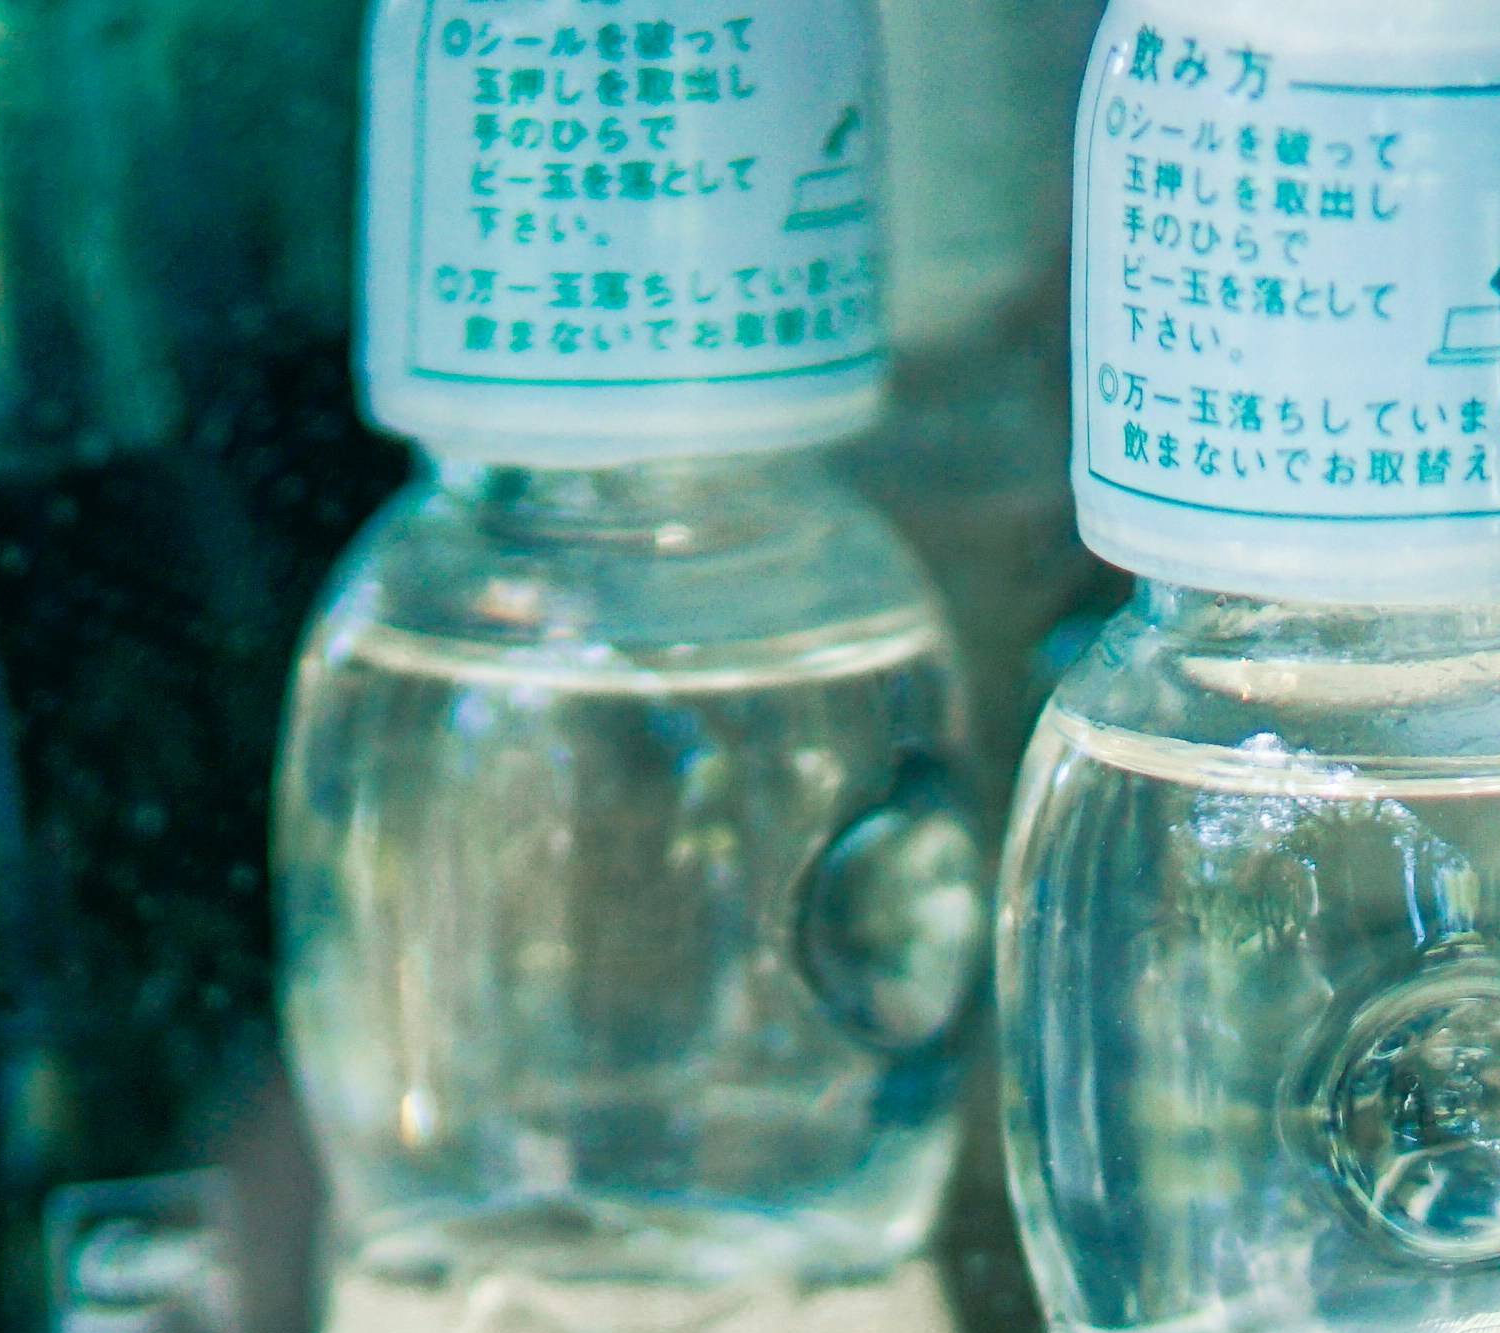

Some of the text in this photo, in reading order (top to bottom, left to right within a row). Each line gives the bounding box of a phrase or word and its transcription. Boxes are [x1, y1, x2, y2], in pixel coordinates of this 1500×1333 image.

[1129, 24, 1274, 100] 飲み方
[1124, 154, 1400, 218] 玉押しを取出し
[1122, 205, 1308, 264] 手のひらで
[1122, 253, 1398, 320] ビー玉を落として
